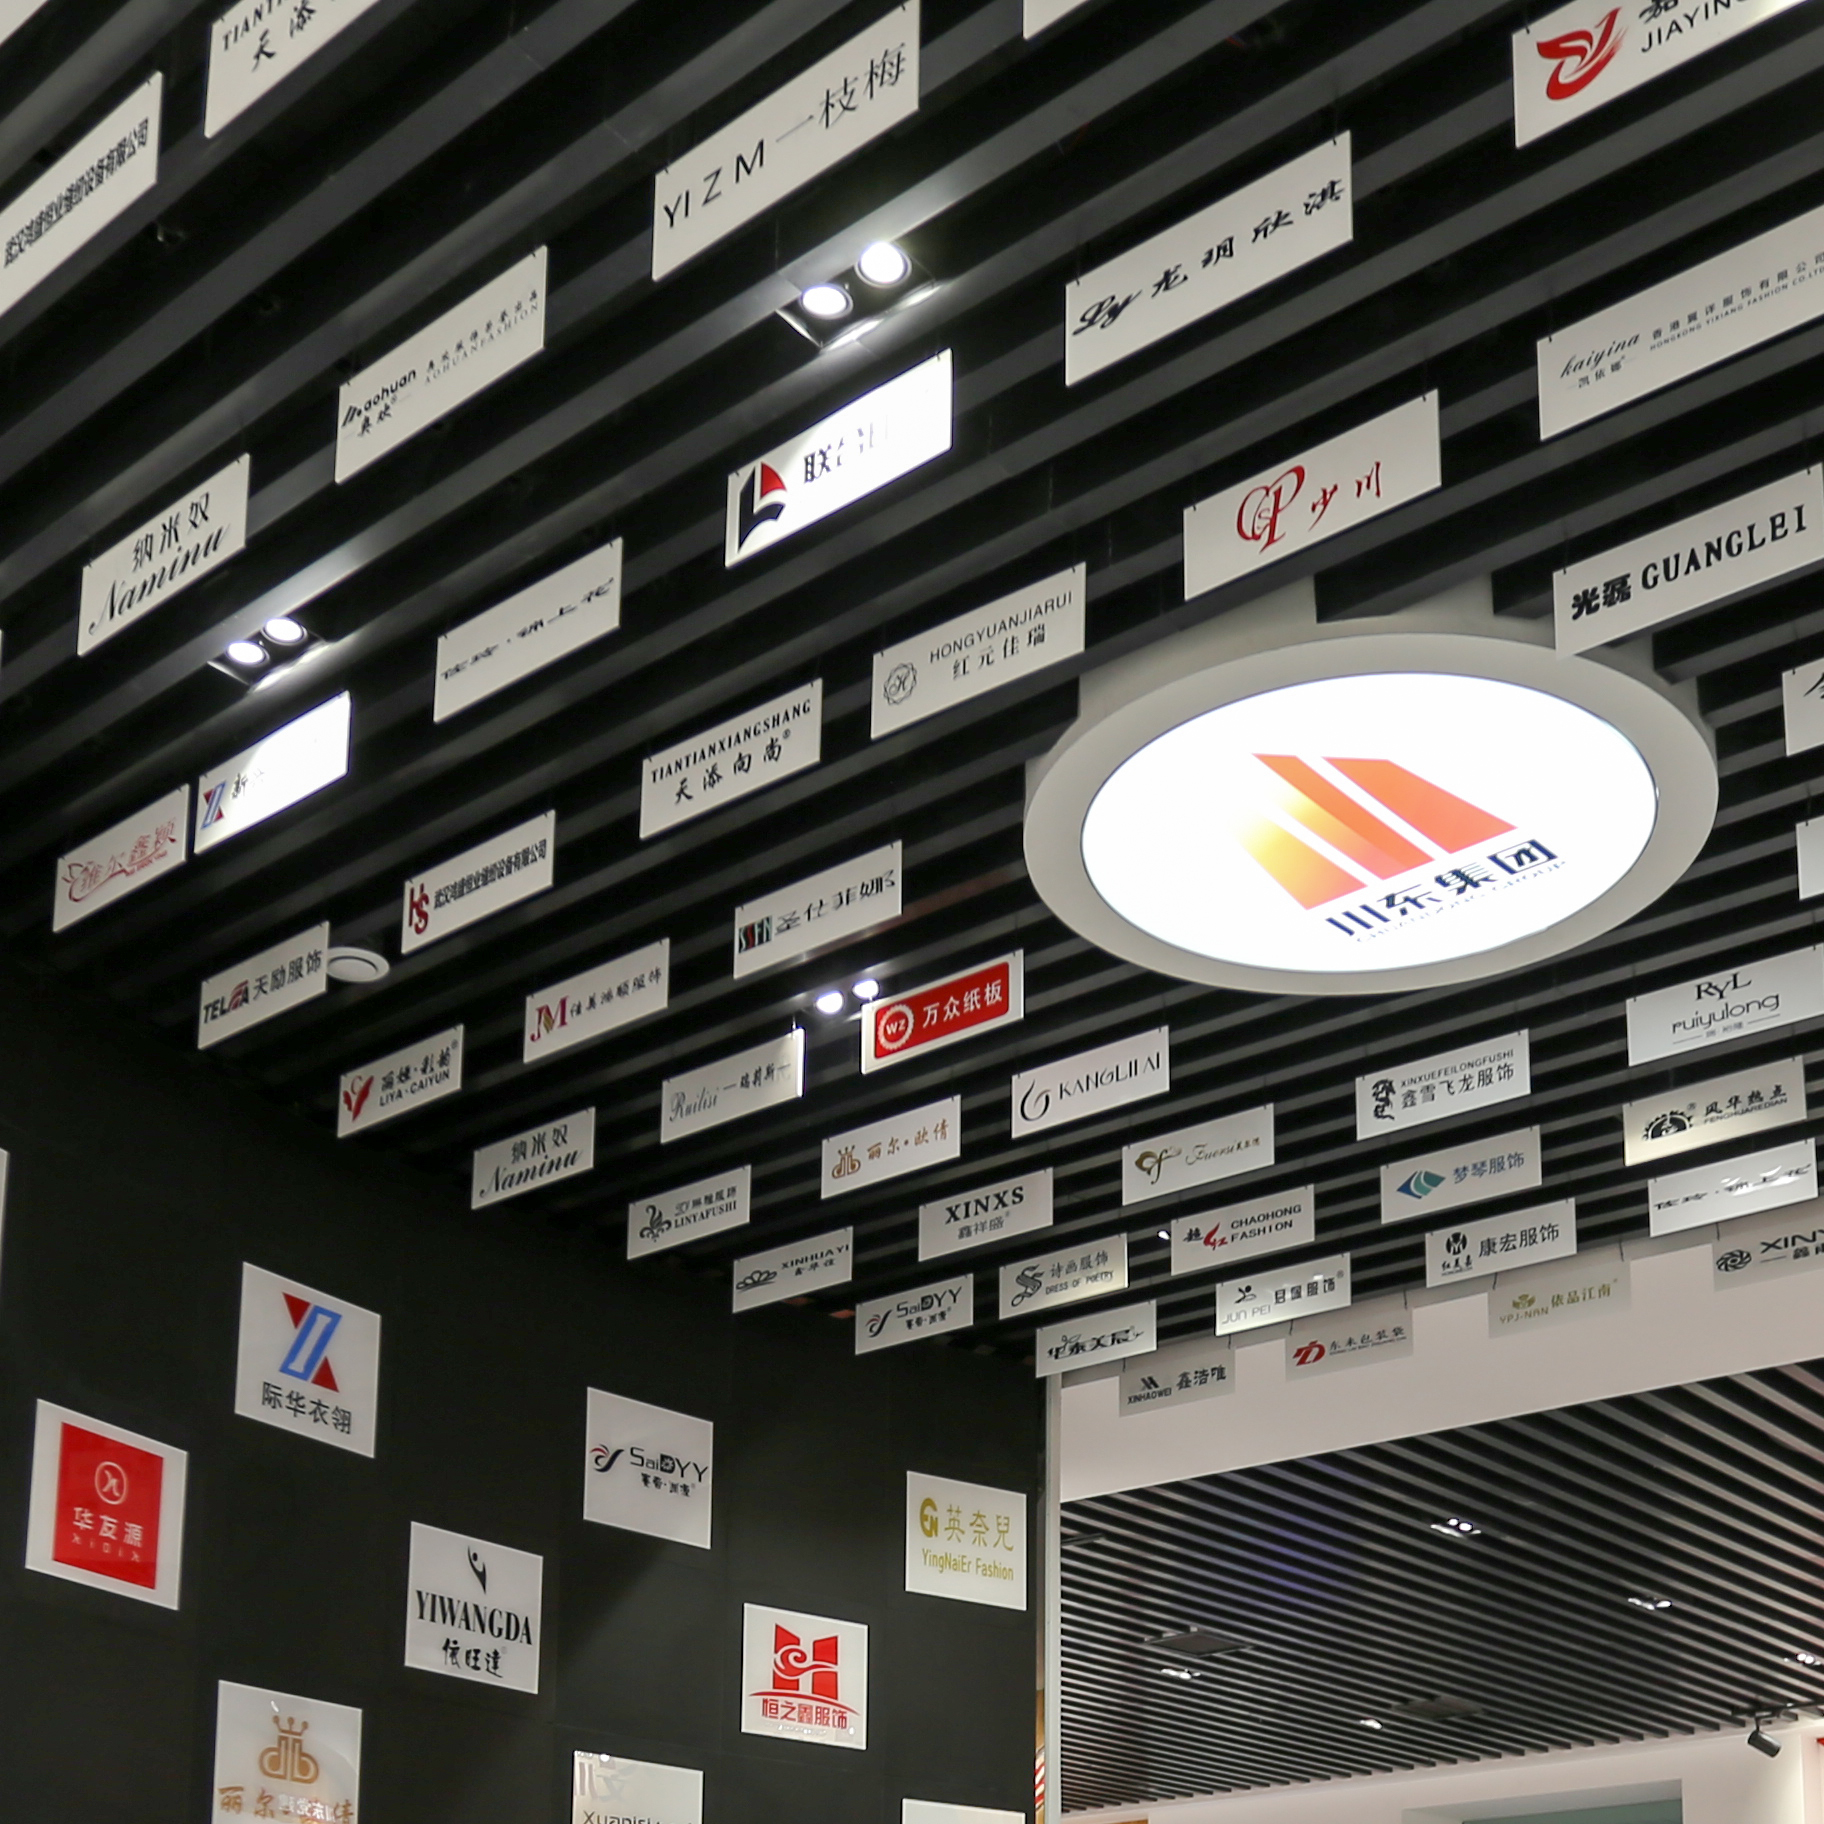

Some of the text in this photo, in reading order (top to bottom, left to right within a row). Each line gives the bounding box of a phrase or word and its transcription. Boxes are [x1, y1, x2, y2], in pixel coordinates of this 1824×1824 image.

[776, 42, 907, 143] 一枝梅
[1747, 285, 1789, 310] FASHION
[1641, 505, 1808, 590] GUANGLEI
[929, 592, 1072, 664] HONGYUANJIARUI
[952, 623, 1046, 680] 红元佳瑞
[651, 700, 811, 783] TIANTIANXIANGSHANG
[1325, 838, 1559, 937] 川东集团
[923, 979, 1002, 1029] 万众纸板
[1694, 972, 1753, 1003] RYL
[1672, 992, 1781, 1036] ruiyulong
[1400, 1049, 1514, 1087] XINXUEFEILONGFUSHI
[1401, 1062, 1515, 1110] 鑫雪飞龙服饰
[1704, 1083, 1787, 1117] 风华热点
[1703, 1096, 1788, 1126] FENGHUAREDIAN
[1452, 1152, 1525, 1184] 梦琴服饰
[674, 1201, 737, 1230] LINYAFUSHI
[945, 1186, 1024, 1225] XINXS
[1230, 1204, 1302, 1229] CHAOHONG
[1231, 1220, 1293, 1242] FASHION
[1477, 1223, 1560, 1258] 康宏服饰
[781, 1244, 849, 1270] XINHUAYI
[1050, 1250, 1109, 1279] 诗画服饰
[1045, 1282, 1068, 1295] DRESS
[1222, 1304, 1271, 1325] JUN PEI
[1127, 1387, 1172, 1404] XINHAOWEI
[73, 1506, 143, 1548] 华友源
[921, 1548, 1014, 1582] YingNaiEr Fashion
[415, 1590, 533, 1645] YIWANGDA
[761, 1698, 848, 1730] 恒之鑫服饰
